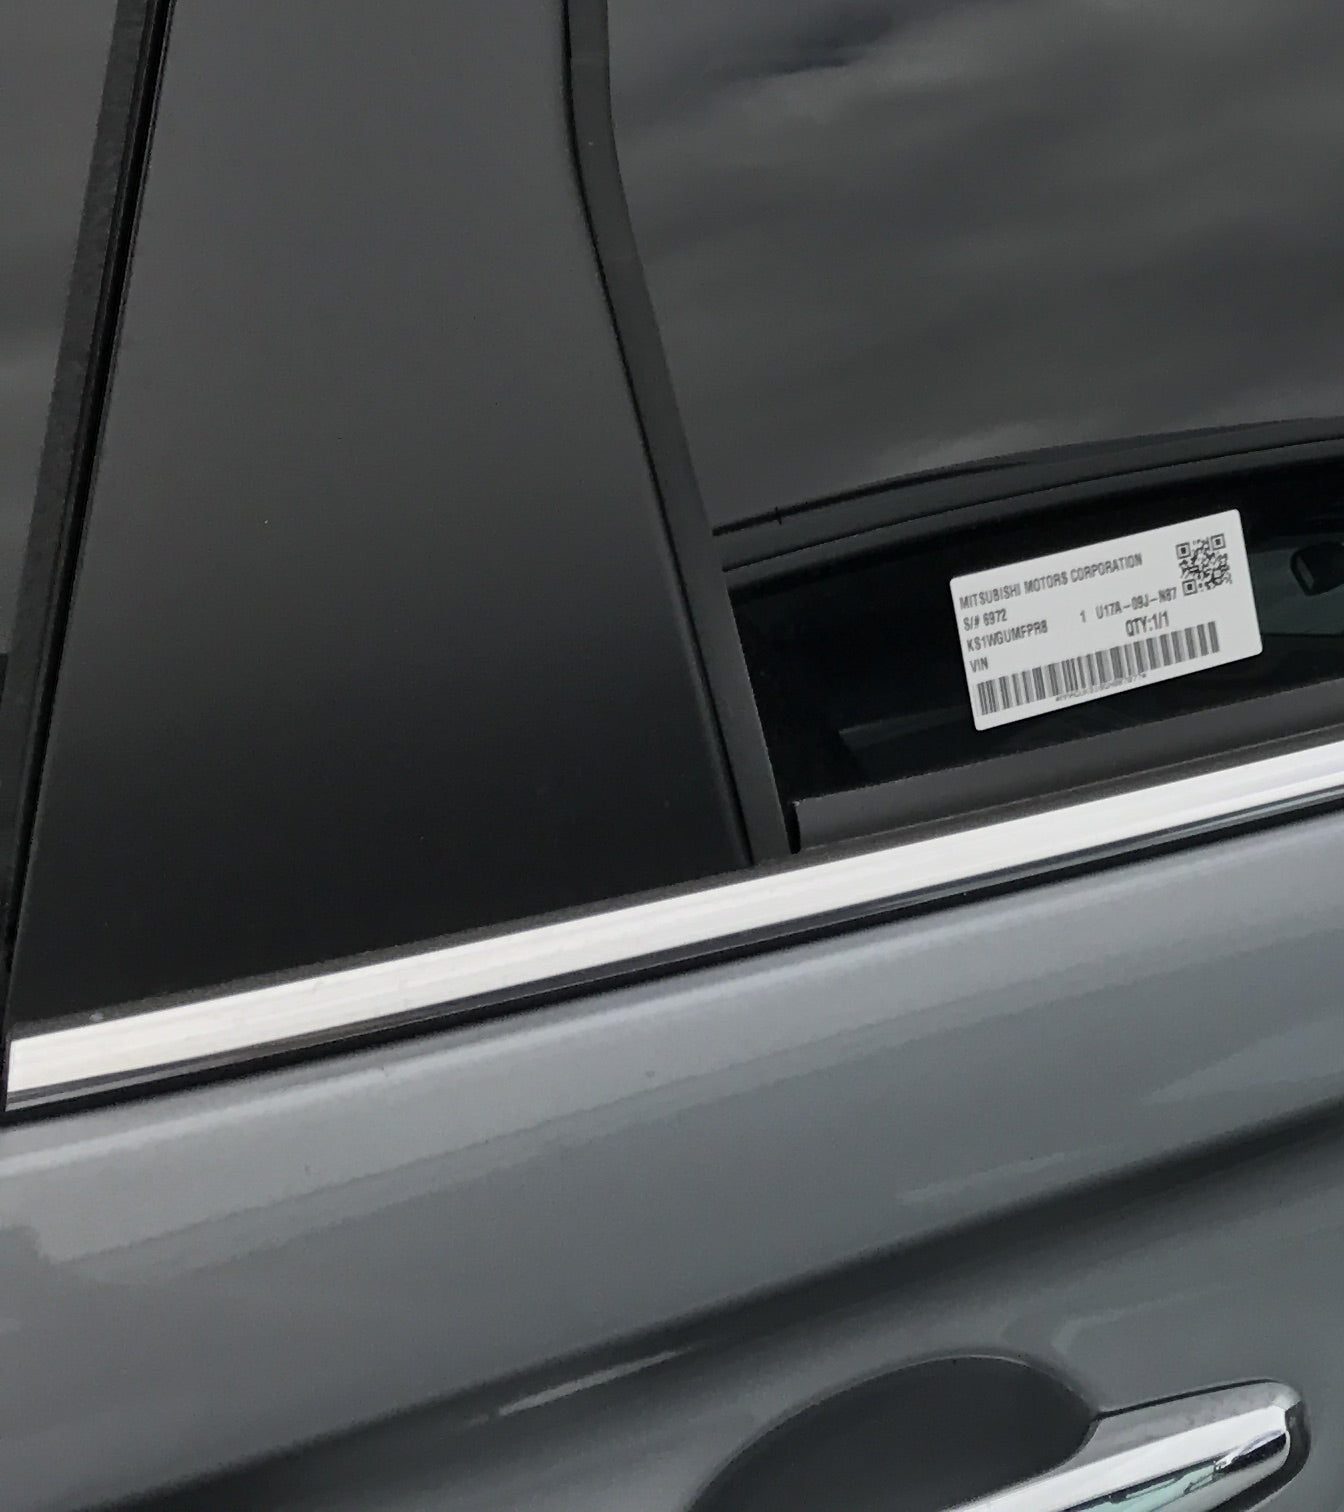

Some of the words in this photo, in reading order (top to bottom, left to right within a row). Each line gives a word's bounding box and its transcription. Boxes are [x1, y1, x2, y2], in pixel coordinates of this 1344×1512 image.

[959, 582, 1021, 610] MITSUBISHI
[1024, 571, 1068, 594] MOTORS
[1070, 553, 1142, 583] CORPORATION
[983, 608, 1007, 626] 6972
[1125, 611, 1169, 637] QTY:1/1
[969, 657, 989, 673] VIN
